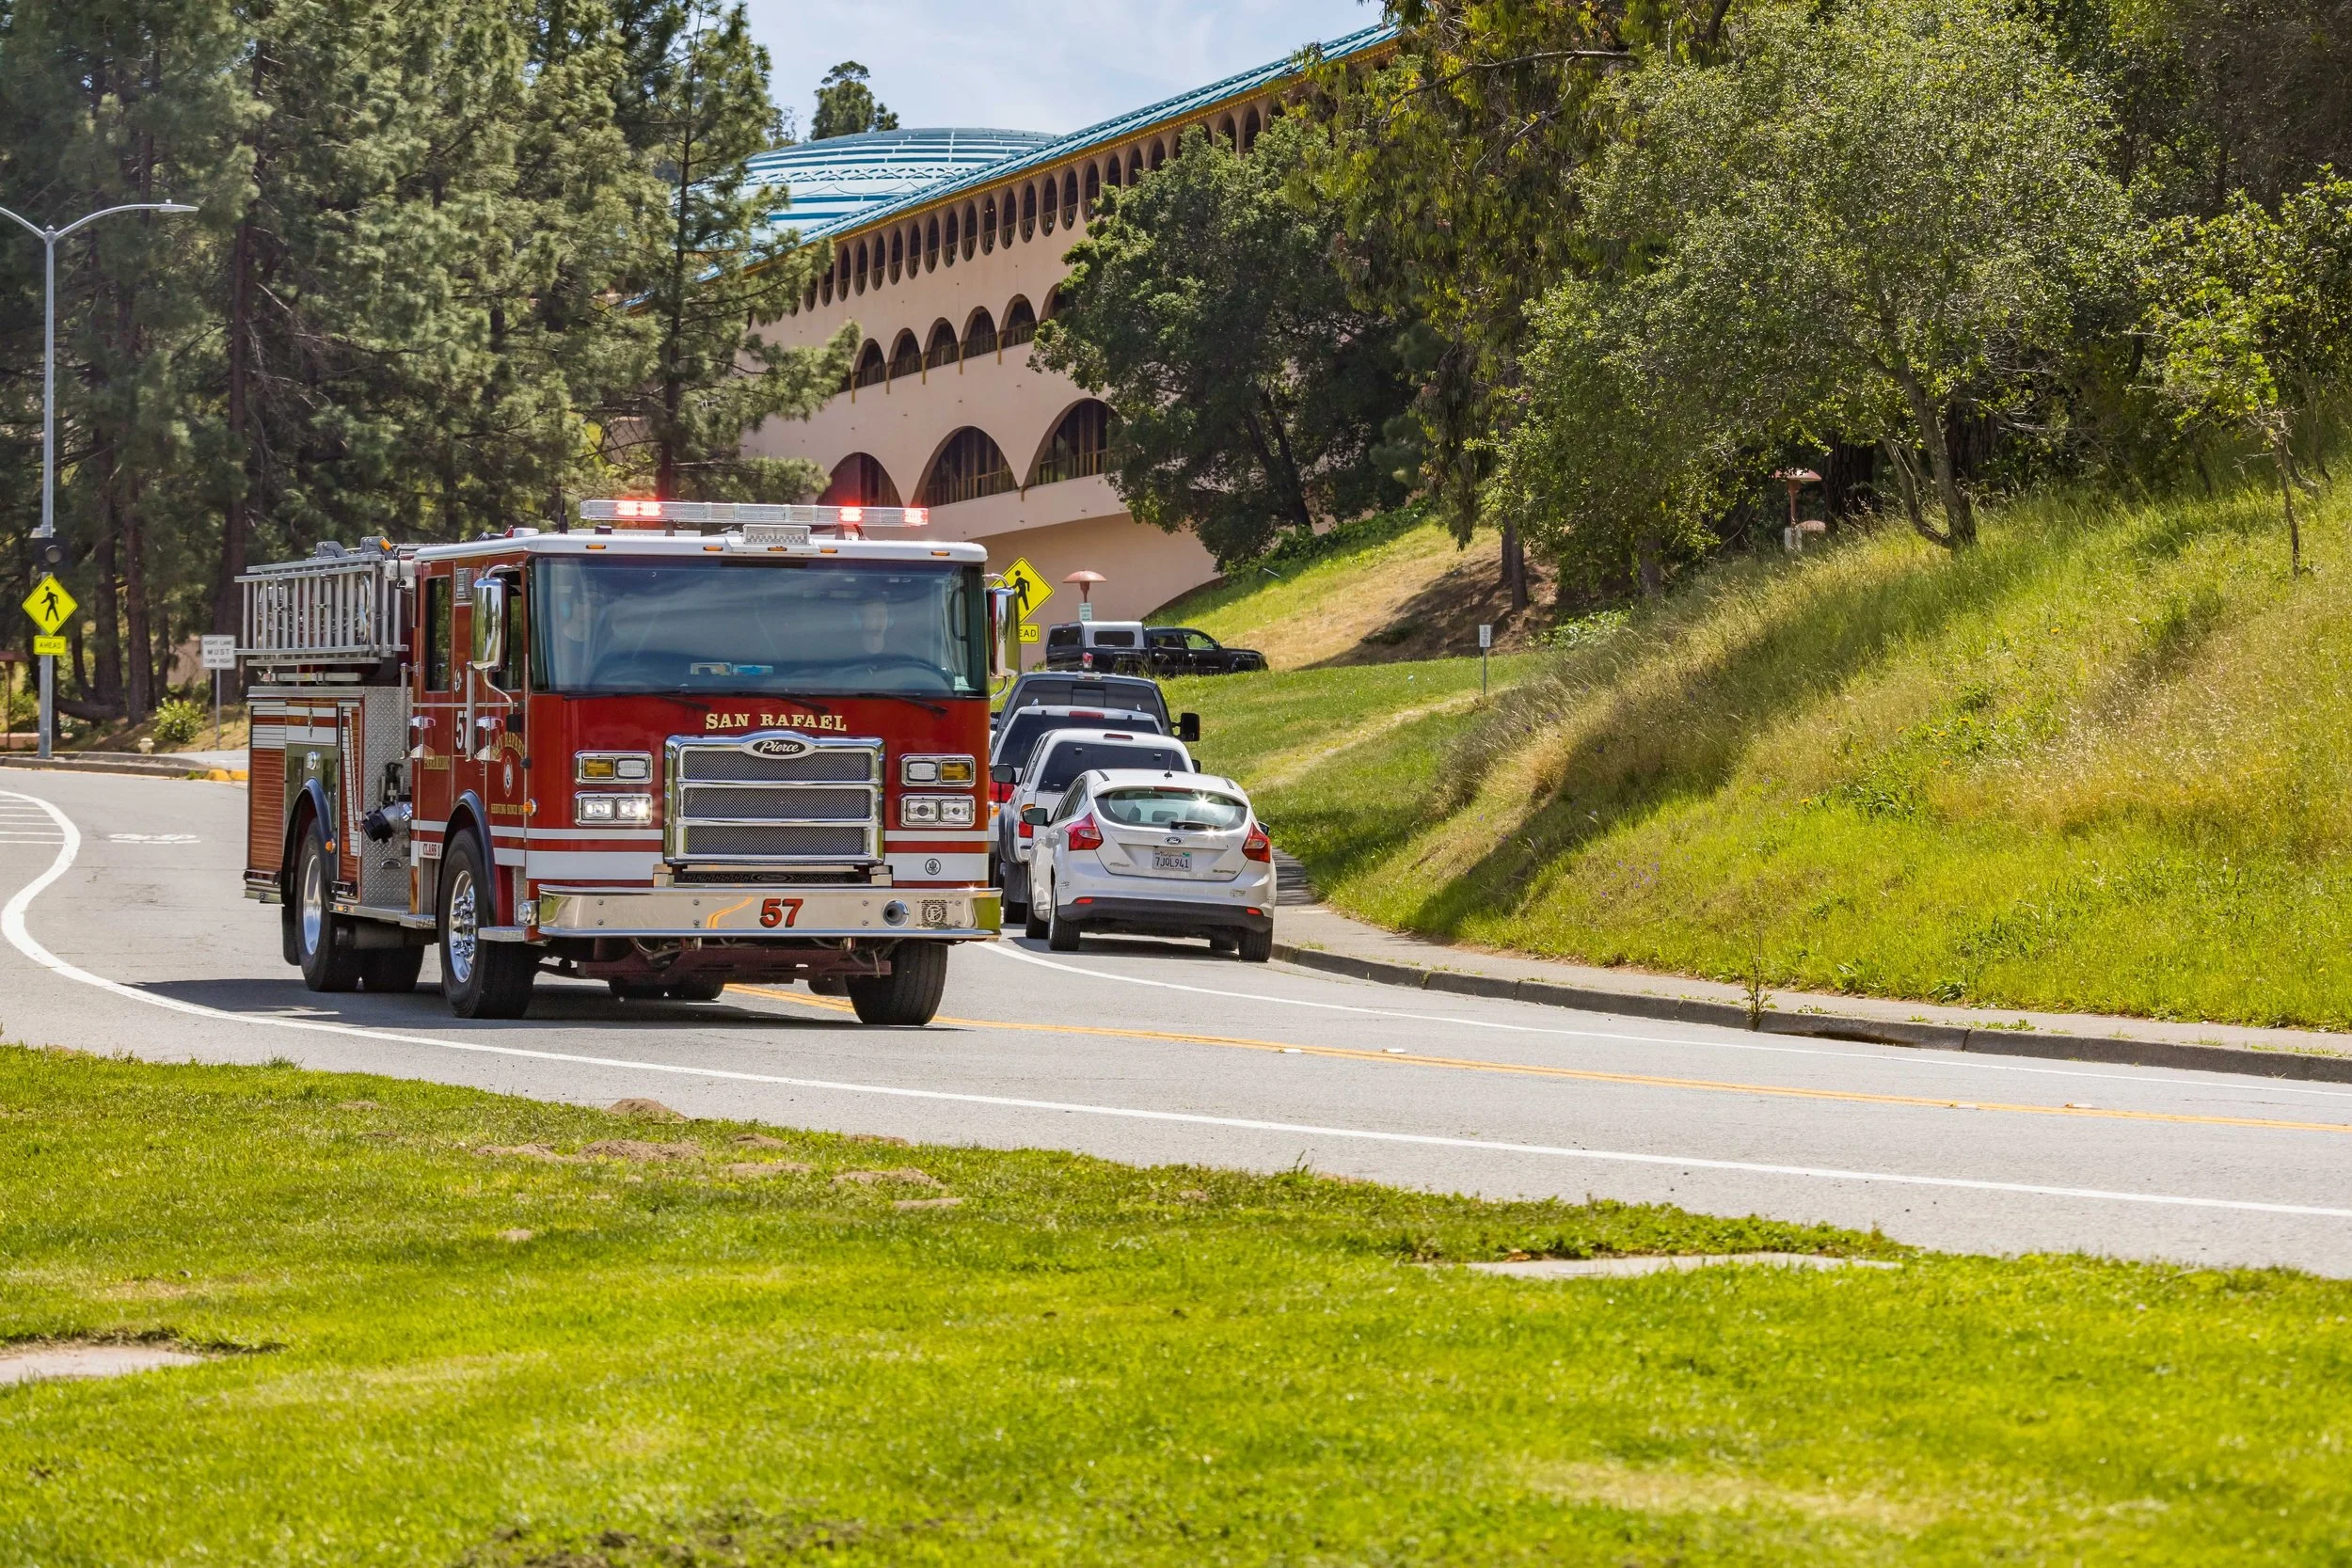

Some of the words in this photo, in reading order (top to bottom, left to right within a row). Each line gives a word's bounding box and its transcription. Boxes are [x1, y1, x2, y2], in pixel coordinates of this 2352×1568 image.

[1019, 629, 1037, 638] EAD
[706, 713, 751, 730] SAN
[760, 713, 847, 732] RAFAEL
[759, 740, 800, 755] Pierce
[423, 843, 437, 856] CLASS
[759, 898, 804, 928] 57
